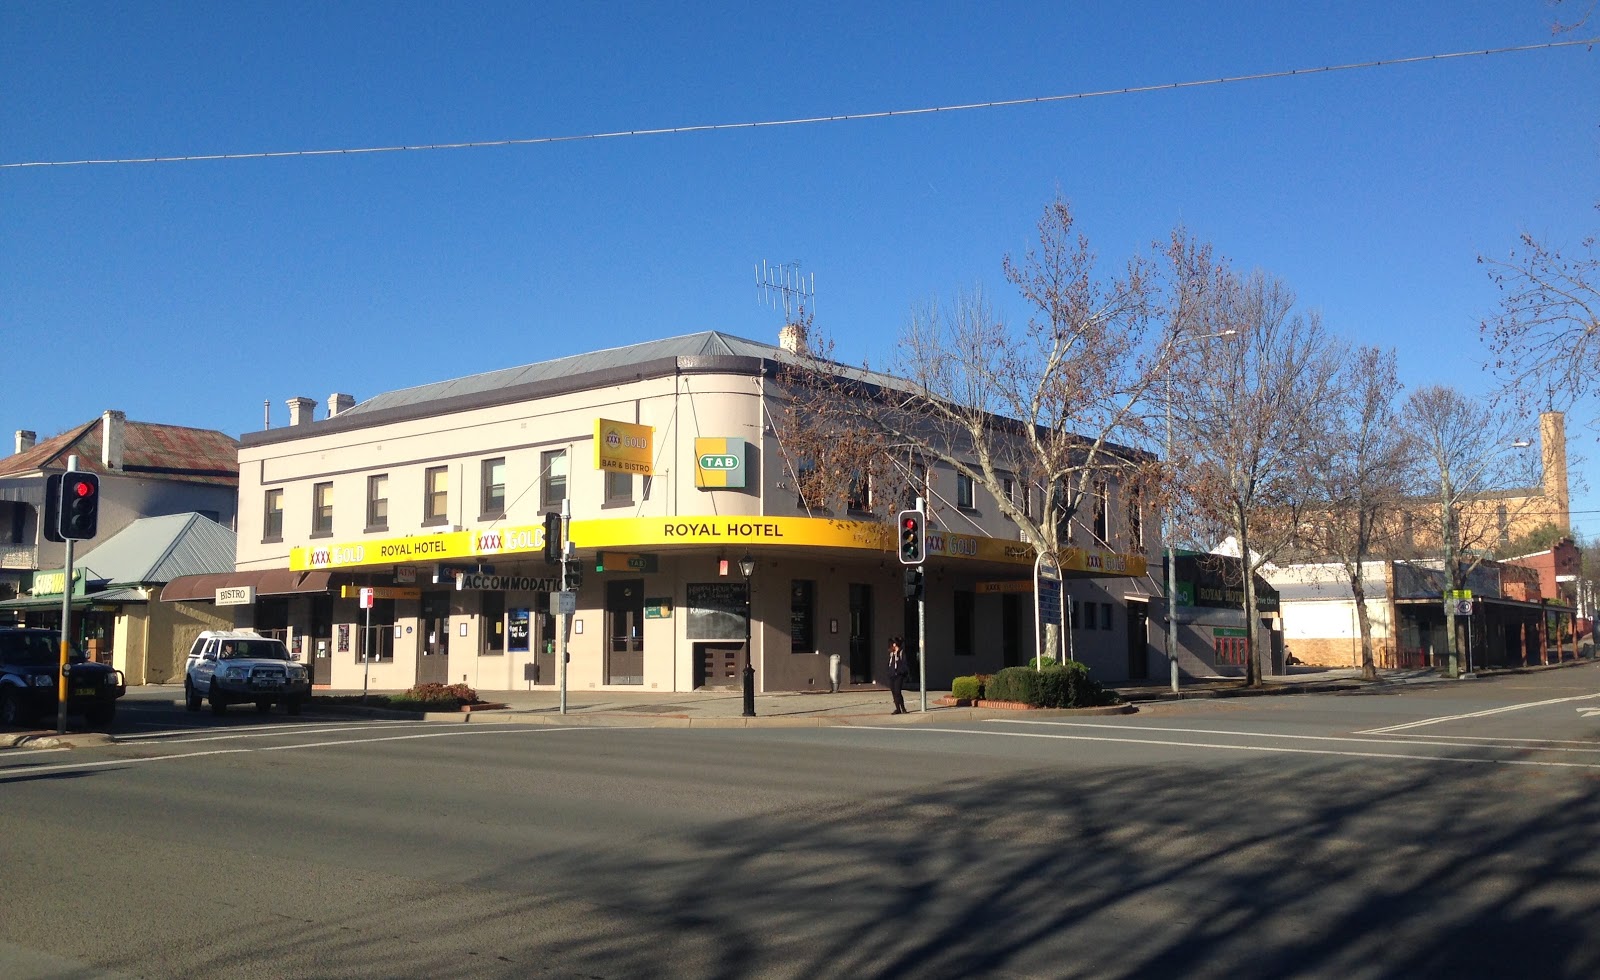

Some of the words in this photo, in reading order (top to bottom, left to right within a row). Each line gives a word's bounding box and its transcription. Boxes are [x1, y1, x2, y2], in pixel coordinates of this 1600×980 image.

[605, 434, 622, 444] XXXX
[623, 435, 647, 449] GOLD
[601, 458, 618, 467] BAR
[618, 461, 623, 469] &
[624, 462, 650, 473] BISTRO
[705, 457, 734, 467] TAB
[664, 524, 721, 536] ROYAL
[727, 524, 783, 537] HOTEL
[476, 535, 503, 550] XXXX
[506, 528, 543, 549] GOLD
[948, 535, 977, 556] GOLD
[309, 551, 332, 565] XXXX
[334, 545, 364, 564] GOLD
[381, 543, 412, 557] ROYAL
[414, 540, 447, 554] HOTEL
[1004, 546, 1029, 559] ROYAL
[1086, 555, 1104, 569] XXXX
[1105, 555, 1126, 572] GOLD
[399, 568, 416, 576] ATM
[32, 568, 81, 597] SUBWA
[220, 589, 246, 601] BISTRO
[1200, 588, 1222, 601] ROYAL
[1225, 588, 1246, 603] HOTE
